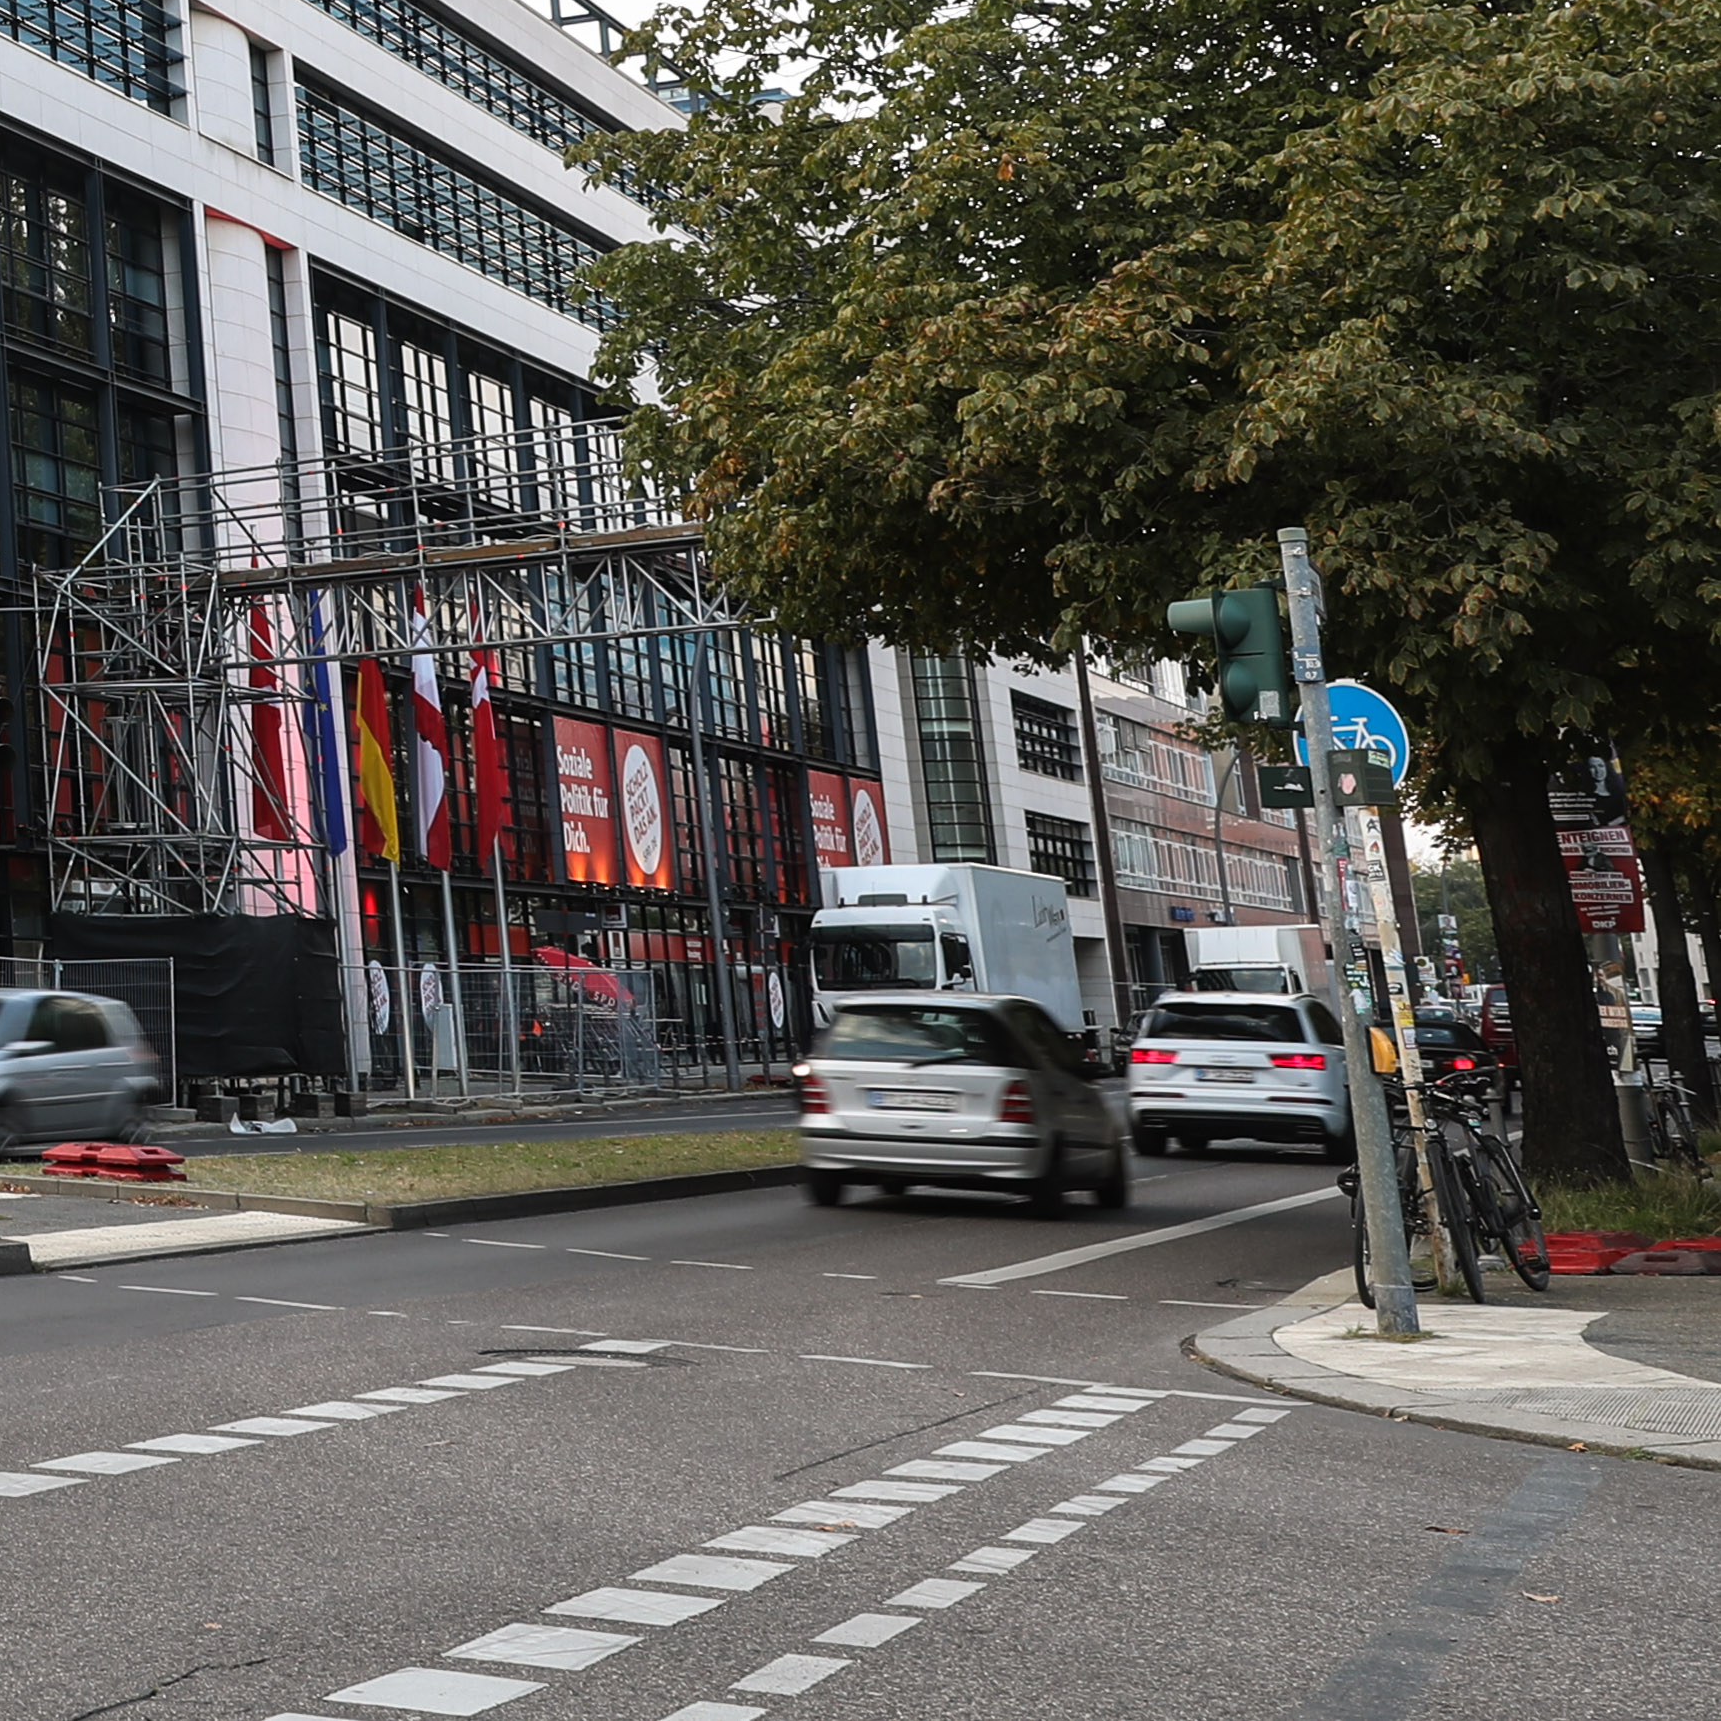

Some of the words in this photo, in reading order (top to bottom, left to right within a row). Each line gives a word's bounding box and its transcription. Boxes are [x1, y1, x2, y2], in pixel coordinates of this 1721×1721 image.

[556, 745, 593, 780] Soziale
[625, 761, 649, 802] SCHOLZ
[560, 783, 592, 816] Politik
[593, 786, 609, 819] für
[630, 787, 650, 824] PACKT
[809, 793, 835, 821] Soziale
[563, 820, 591, 854] Dich.
[633, 816, 647, 844] DAS
[813, 824, 835, 852] Politik
[835, 826, 847, 853] für
[1591, 919, 1617, 929] DKP
[593, 991, 616, 1007] SPD
